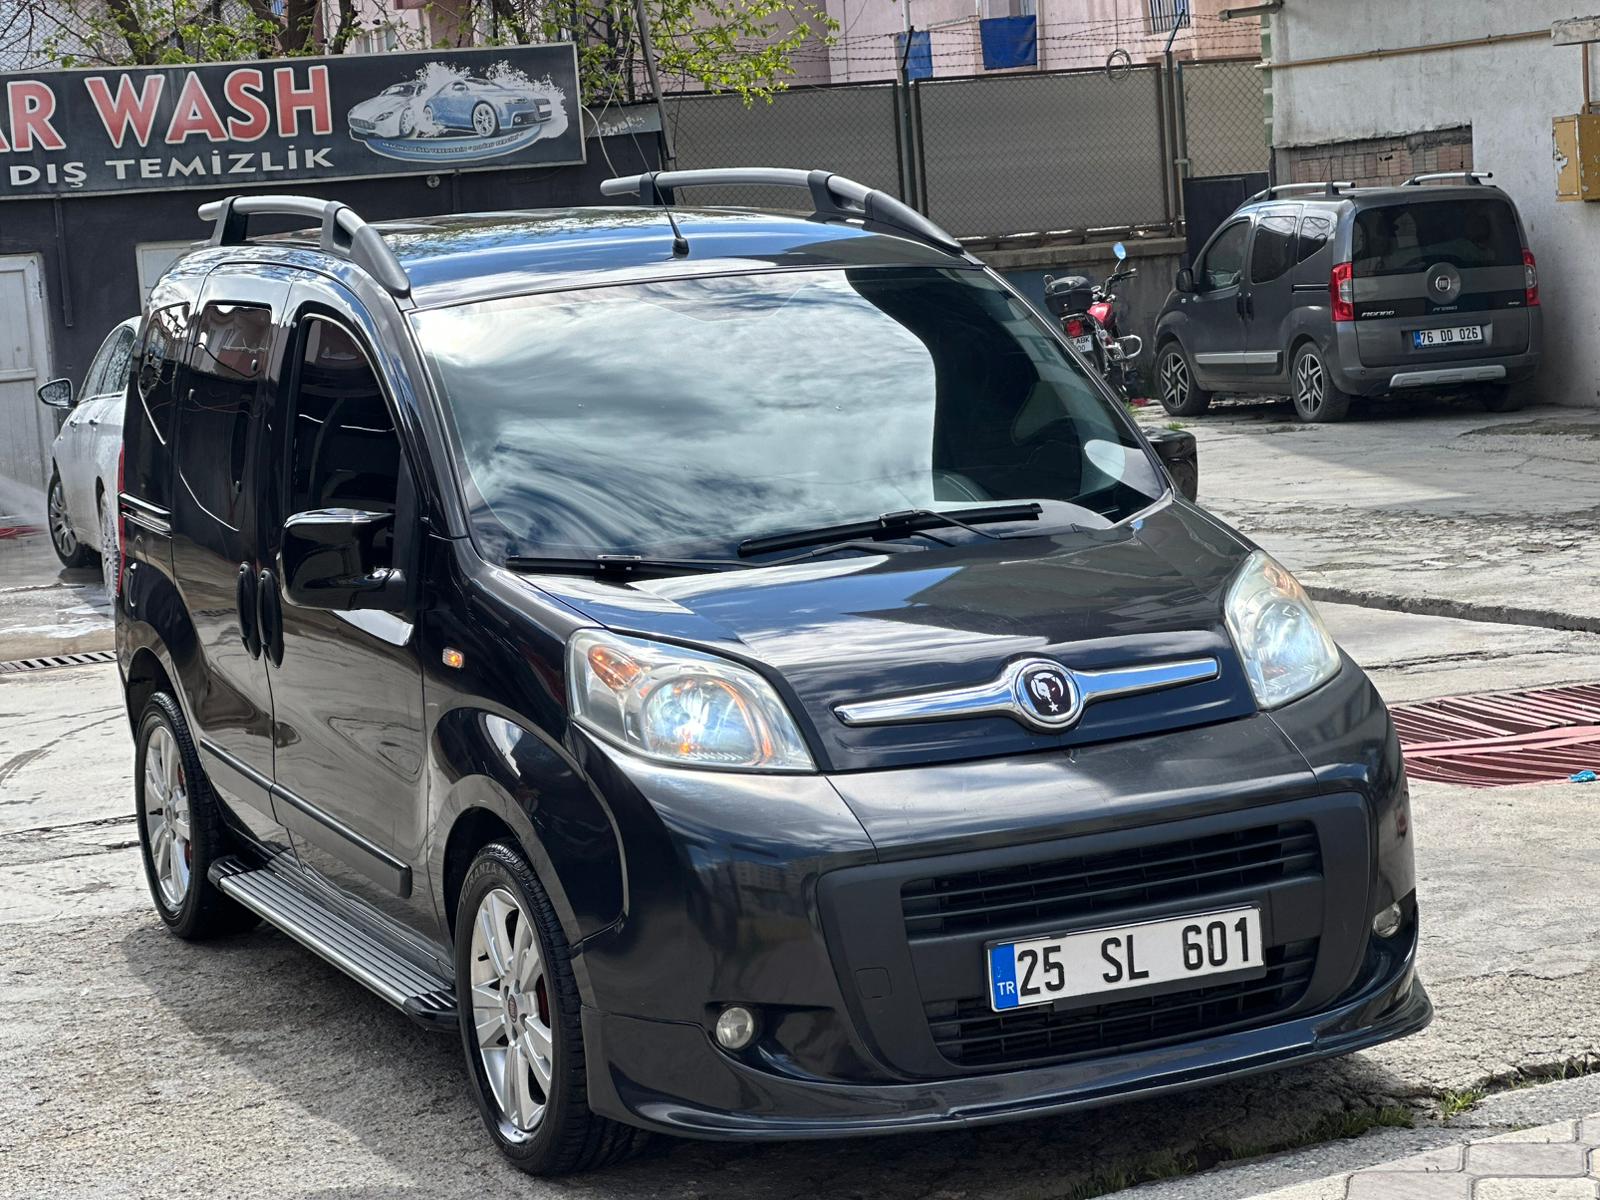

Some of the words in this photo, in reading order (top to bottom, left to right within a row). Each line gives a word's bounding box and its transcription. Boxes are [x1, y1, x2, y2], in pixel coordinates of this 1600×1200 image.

[0, 80, 67, 152] R
[84, 65, 333, 149] WASH
[9, 161, 87, 188] DIŞ
[105, 145, 335, 180] TEMİZLİK
[1421, 331, 1434, 343] 76
[1459, 327, 1478, 340] 026
[997, 981, 1015, 996] TR
[1017, 945, 1066, 997] 25
[1101, 934, 1150, 984] SL
[1181, 916, 1250, 971] 601
